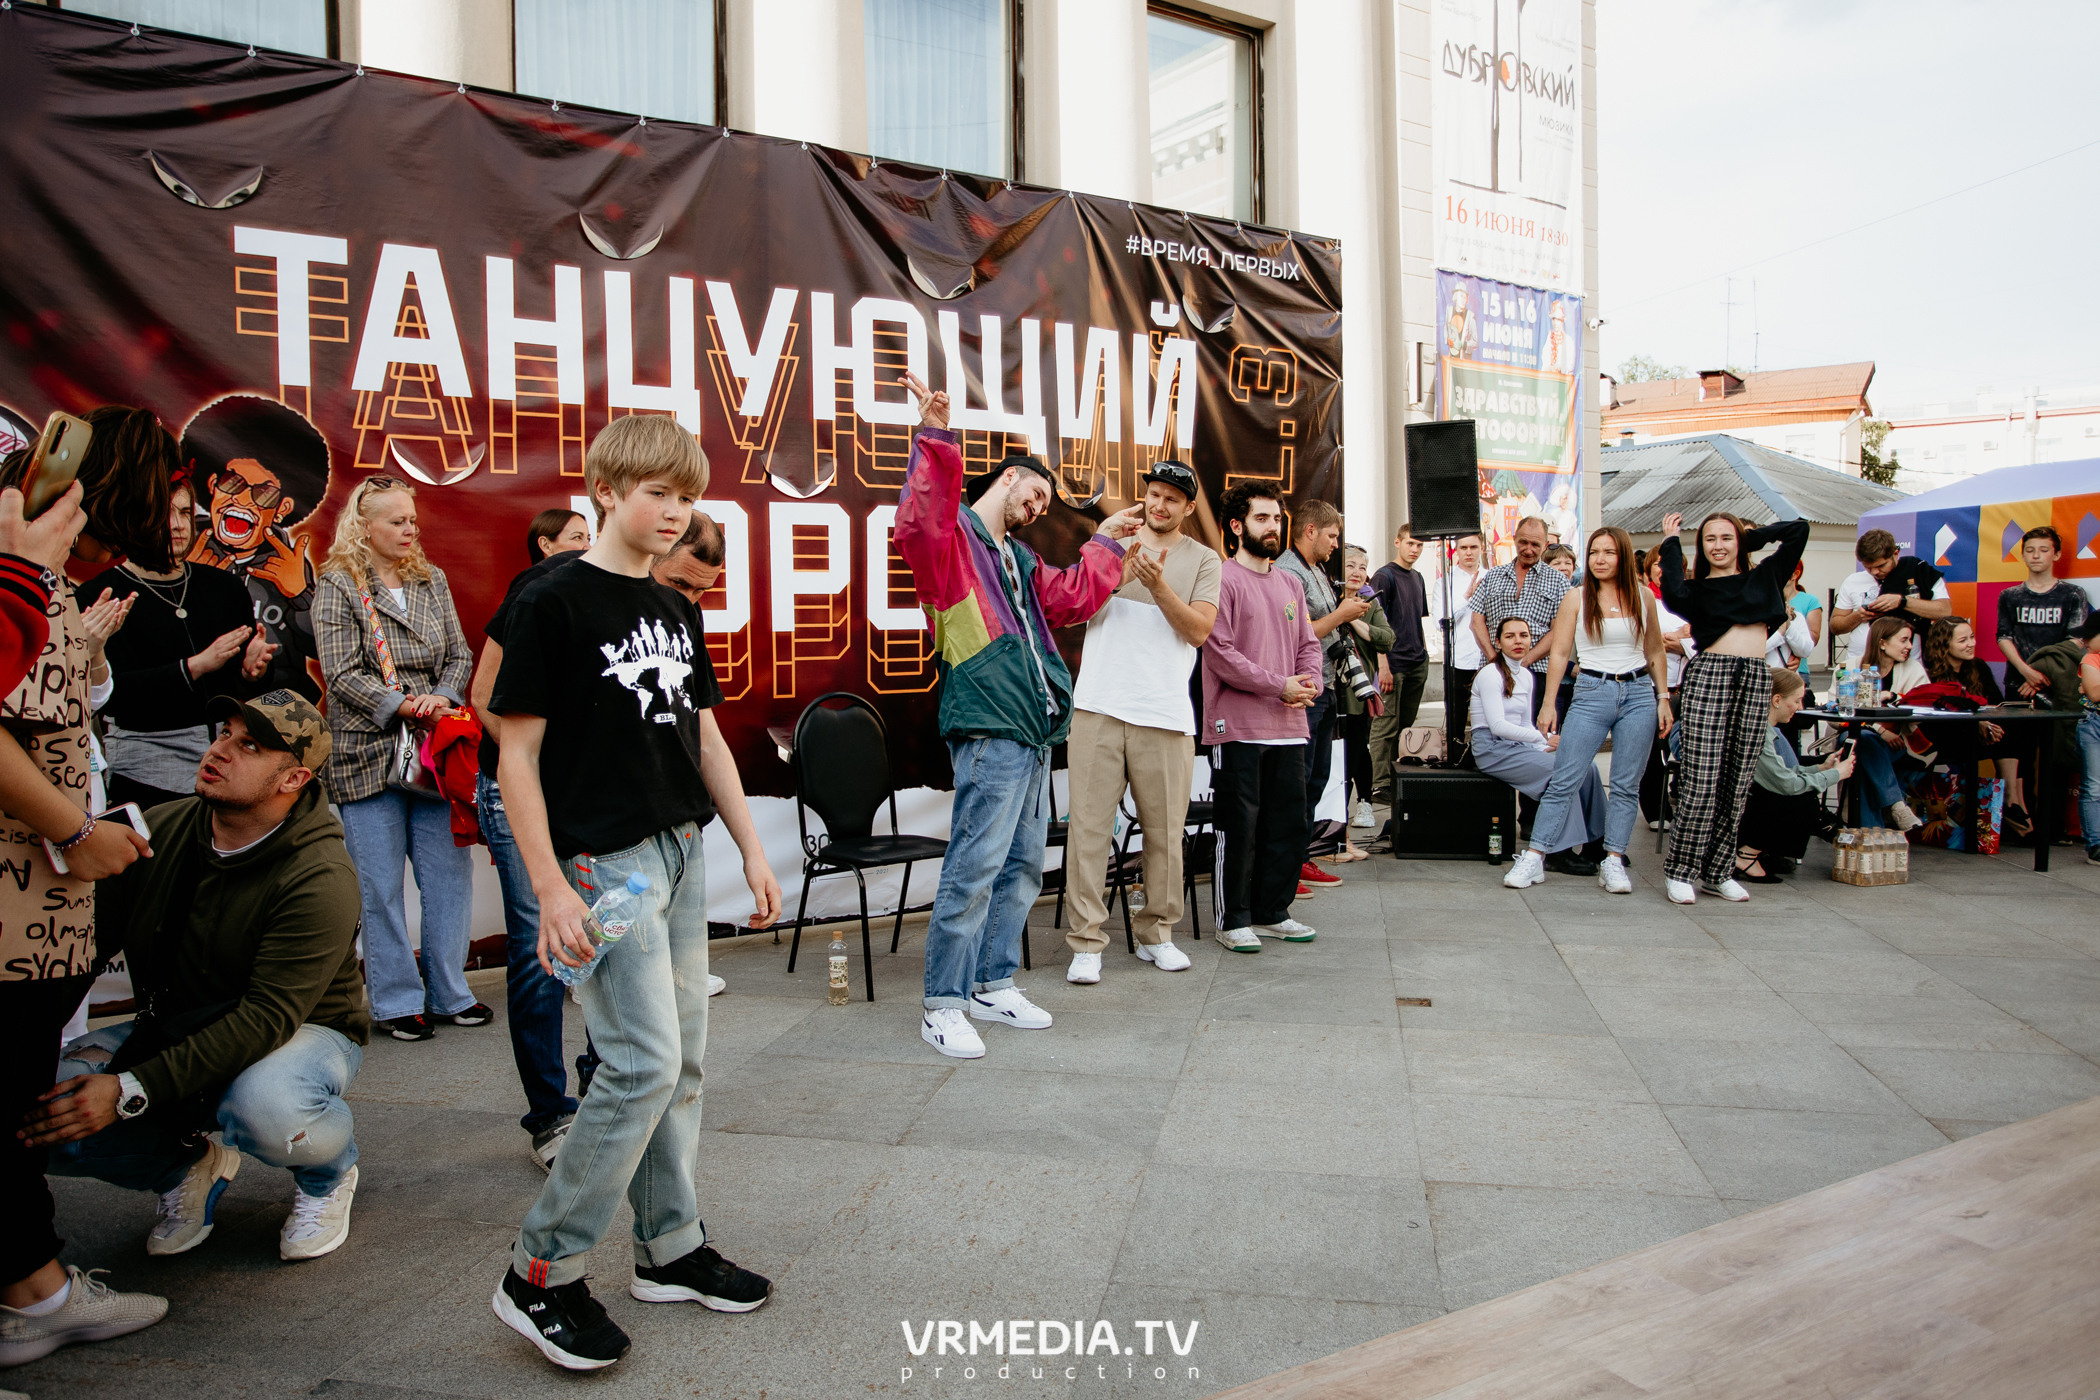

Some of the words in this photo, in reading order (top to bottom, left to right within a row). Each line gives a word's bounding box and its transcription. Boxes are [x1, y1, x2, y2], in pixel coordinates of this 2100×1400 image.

[1443, 40, 1576, 110] ДУБРОВСКИЙ
[1445, 195, 1468, 225] 16
[1126, 235, 1299, 281] #ВРЕМЯ_ПЕРВЫХ
[1482, 290, 1501, 318] 15
[1518, 298, 1537, 324] 16
[234, 226, 1196, 455] ТАНЦУЮЩИЙ
[1482, 321, 1533, 349] ИЮНЯ
[2016, 606, 2062, 624] LEADER
[529, 1302, 546, 1313] FILA
[543, 1323, 562, 1337] FILA
